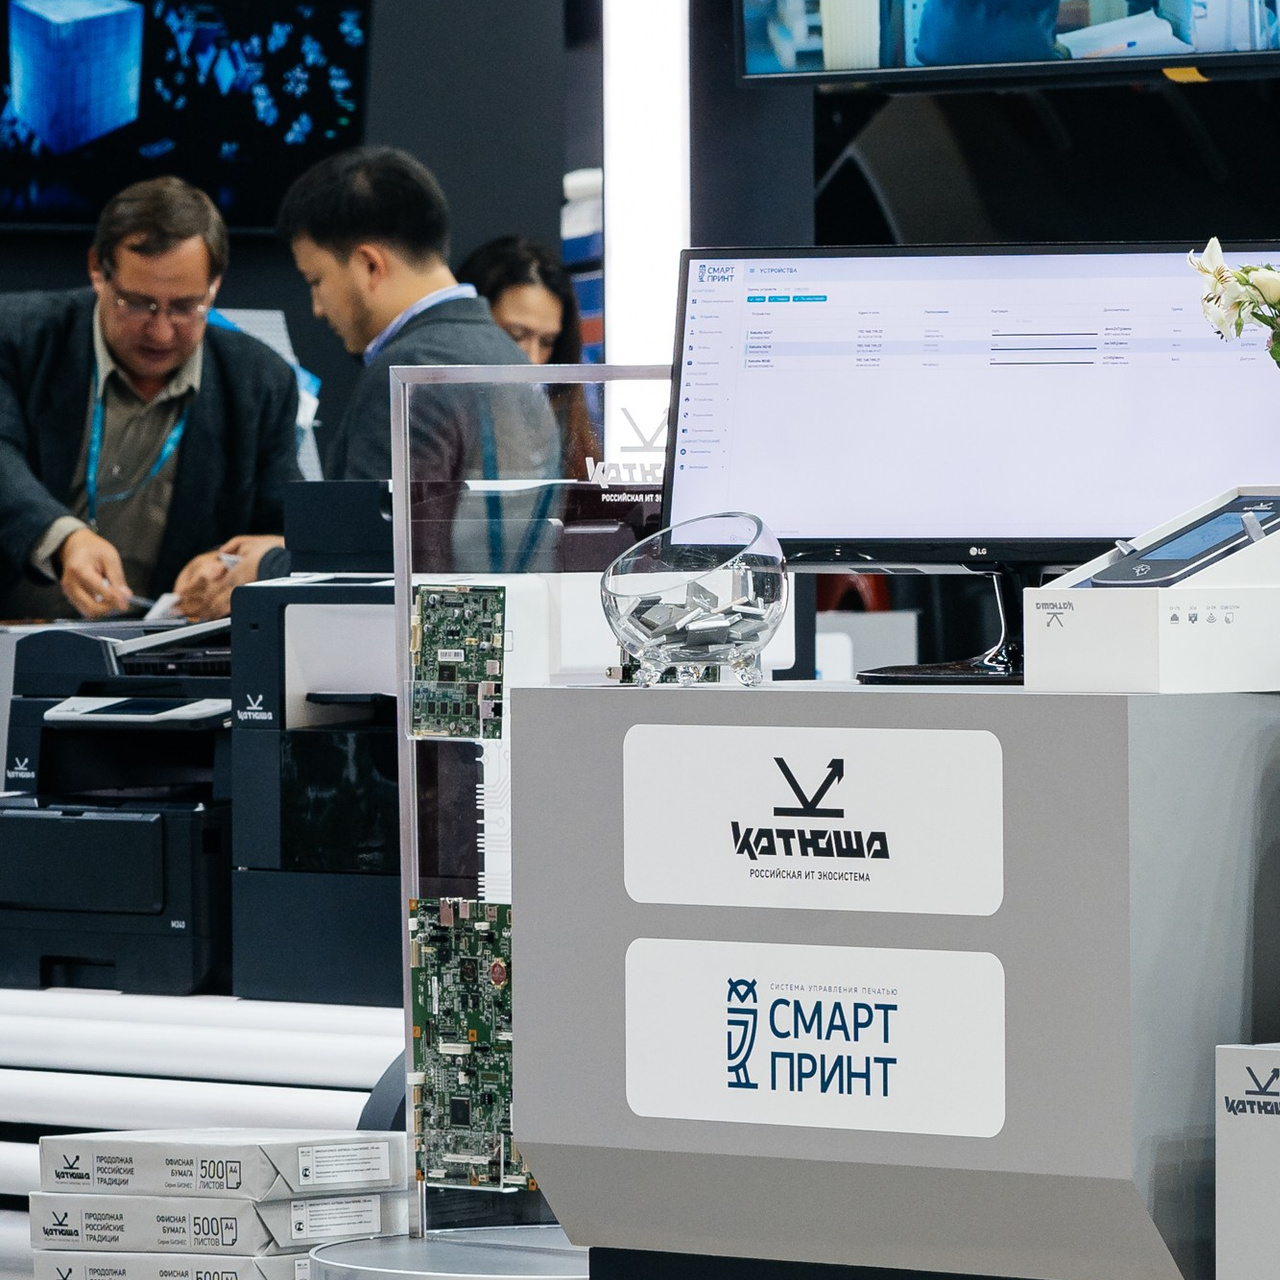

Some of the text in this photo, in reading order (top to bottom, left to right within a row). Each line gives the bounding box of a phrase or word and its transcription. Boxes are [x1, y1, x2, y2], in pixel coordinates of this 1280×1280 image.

[707, 266, 735, 275] СМАРТ
[707, 275, 735, 283] ПРИНТ
[602, 492, 643, 502] РОССИЙСКАЯ
[645, 494, 653, 502] ИТ
[749, 867, 871, 882] РОССИЙСКАЯ ИТ ЭКОСИСТЕМА
[770, 983, 898, 996] СИСТЕМА УПРАВЛЕНИЯ ПЕЧАТЬЮ
[769, 997, 898, 1044] СМАРТ
[770, 1051, 898, 1097] ПРИНТ
[96, 1156, 133, 1164] ПРОДОЛЖАЯ
[165, 1158, 194, 1167] ОФИСНАЯ
[97, 1166, 135, 1176] РОССИЙСКИЕ
[171, 1169, 194, 1177] БУМАГА
[200, 1160, 238, 1179] 500 A4
[97, 1177, 129, 1186] ТРАДИЦИИ
[199, 1181, 225, 1190] ЛИСТОВ
[85, 1212, 123, 1221] ПРОДОЛЖАЯ
[156, 1215, 186, 1223] ОФИСНАЯ
[85, 1223, 125, 1232] РОССИЙСКИЕ
[162, 1226, 186, 1234] БУМАГА
[193, 1217, 234, 1236] 500 A4
[86, 1234, 119, 1243] ТРАДИЦИИ
[193, 1237, 220, 1246] ЛИСТОВ
[89, 1268, 126, 1276] ПРОДОЛЖАЯ
[159, 1270, 189, 1278] ОФИСНАЯ
